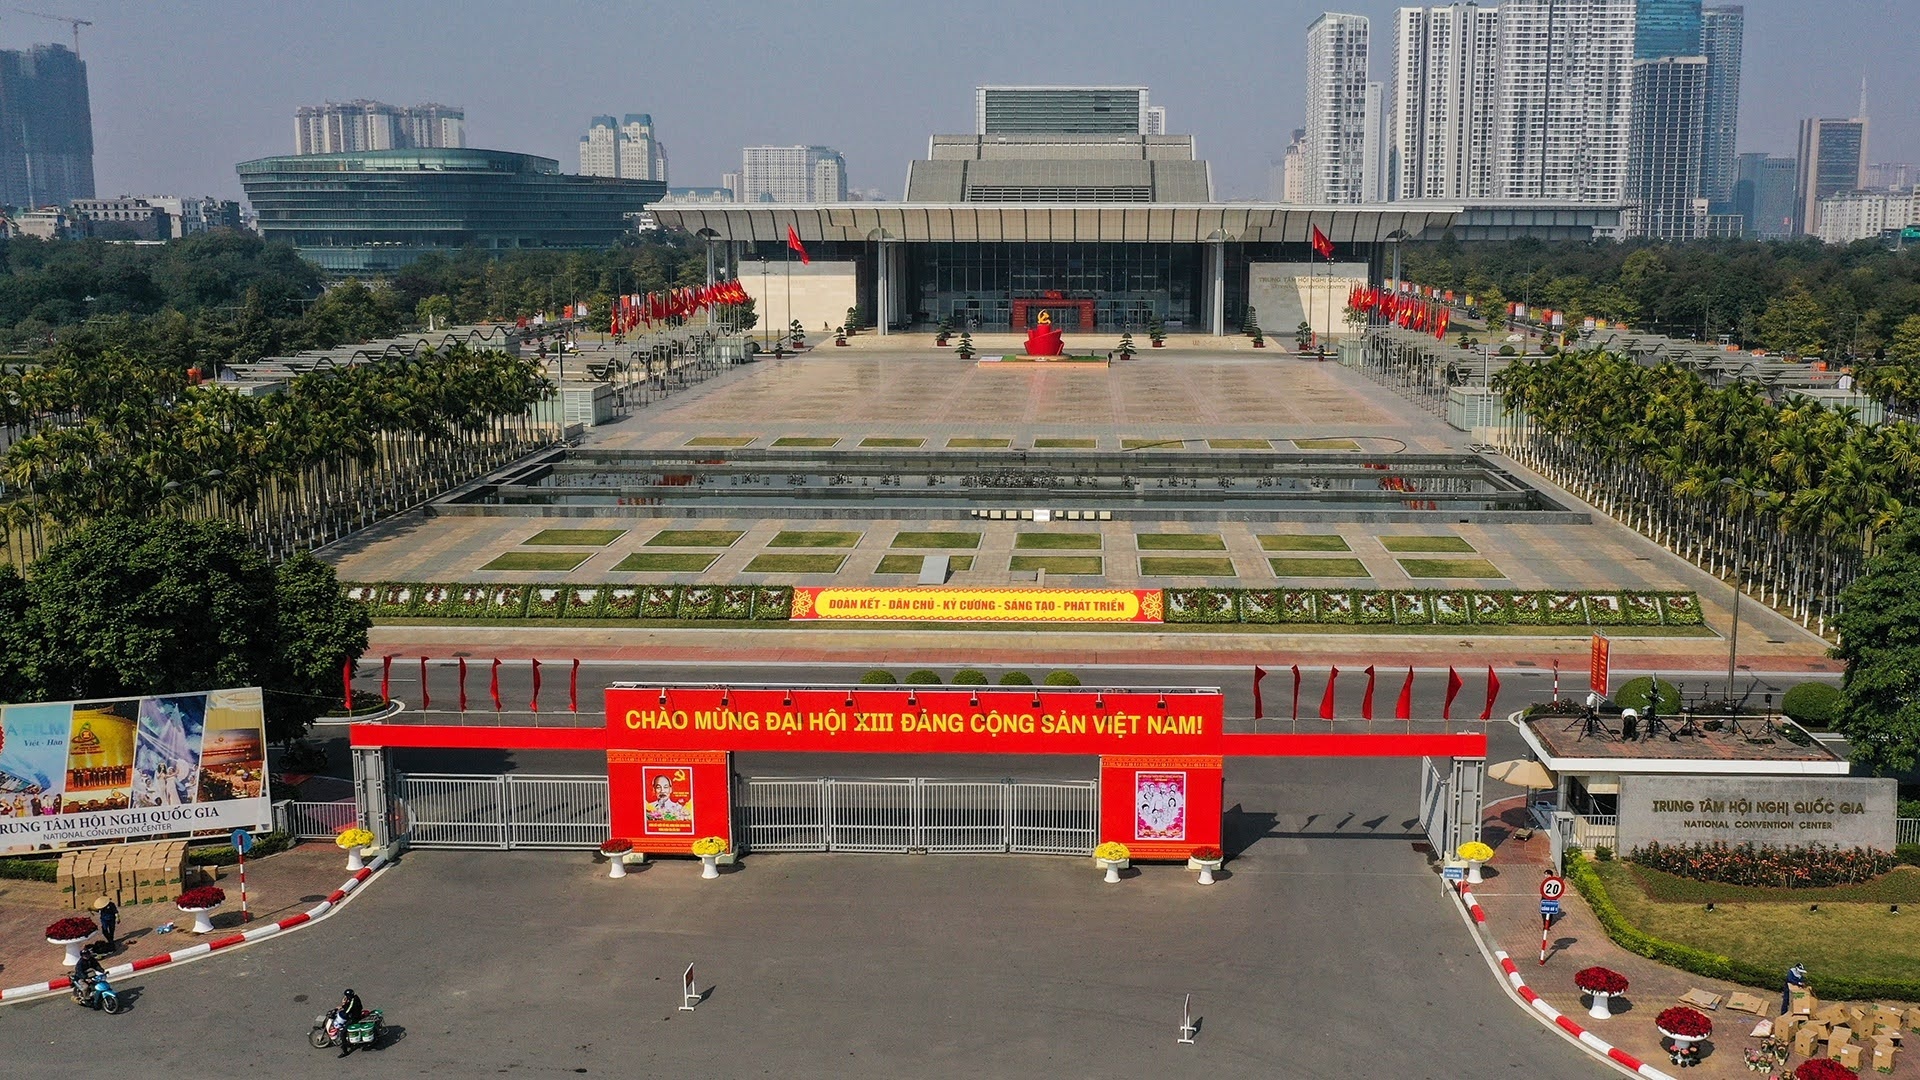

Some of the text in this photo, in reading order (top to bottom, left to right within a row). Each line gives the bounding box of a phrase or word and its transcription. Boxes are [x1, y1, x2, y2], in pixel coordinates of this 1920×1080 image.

[860, 596, 880, 609] KẾT
[888, 597, 910, 609] DÂN
[912, 597, 934, 610] CHỦ
[943, 598, 957, 610] KỶ
[959, 598, 996, 610] CƯƠNG
[1004, 599, 1033, 611] SÁNG
[1036, 600, 1055, 613] TẠO
[1064, 599, 1091, 611] PHÁT
[1093, 598, 1125, 611] TRIỂN
[625, 707, 1203, 738] CHÀO MỪNG ĐẠI HỘI XIII ĐẢNG CỘNG SẢN VIỆT NAM!
[1652, 798, 1865, 816] TRUNG TÂM HỘI NGHỊ QUỐC GIA
[0, 806, 219, 835] RUNG TÂM HỘI NGHỊ QUỐC GIA
[1683, 820, 1833, 830] NATIONAL CONVENTION CENTER
[43, 823, 172, 841] NATIONAL CONVENTION CENTER
[1545, 883, 1560, 895] 20
